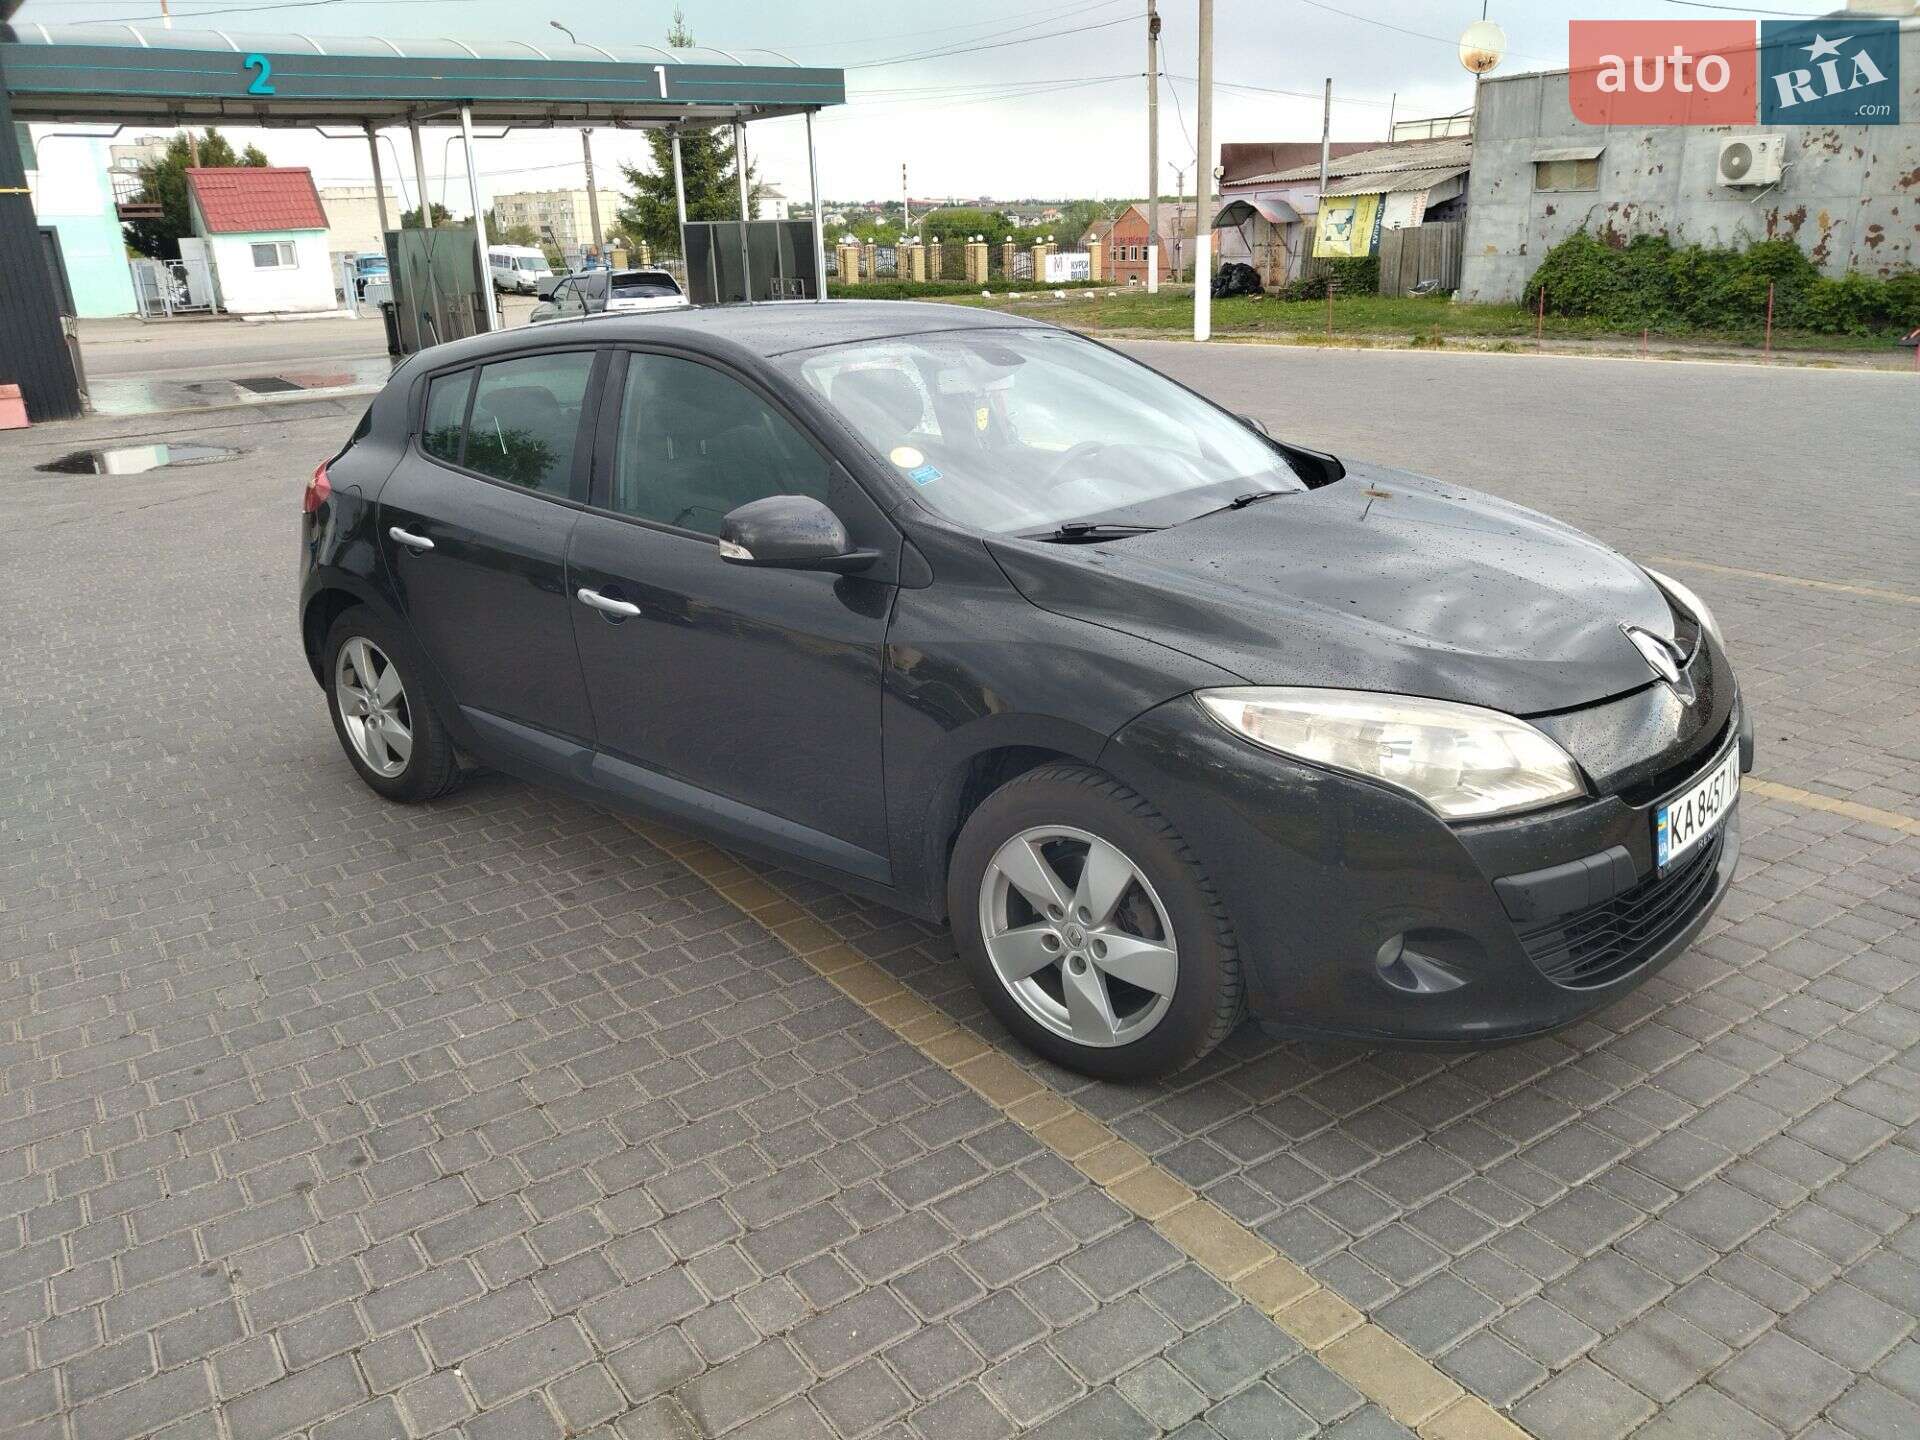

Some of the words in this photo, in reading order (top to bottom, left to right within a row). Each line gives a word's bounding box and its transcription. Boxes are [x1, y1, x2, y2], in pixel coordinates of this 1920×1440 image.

[244, 53, 275, 95] 2
[653, 65, 668, 99] 1
[1671, 799, 1694, 849] KA
[1698, 770, 1726, 828] 8457
